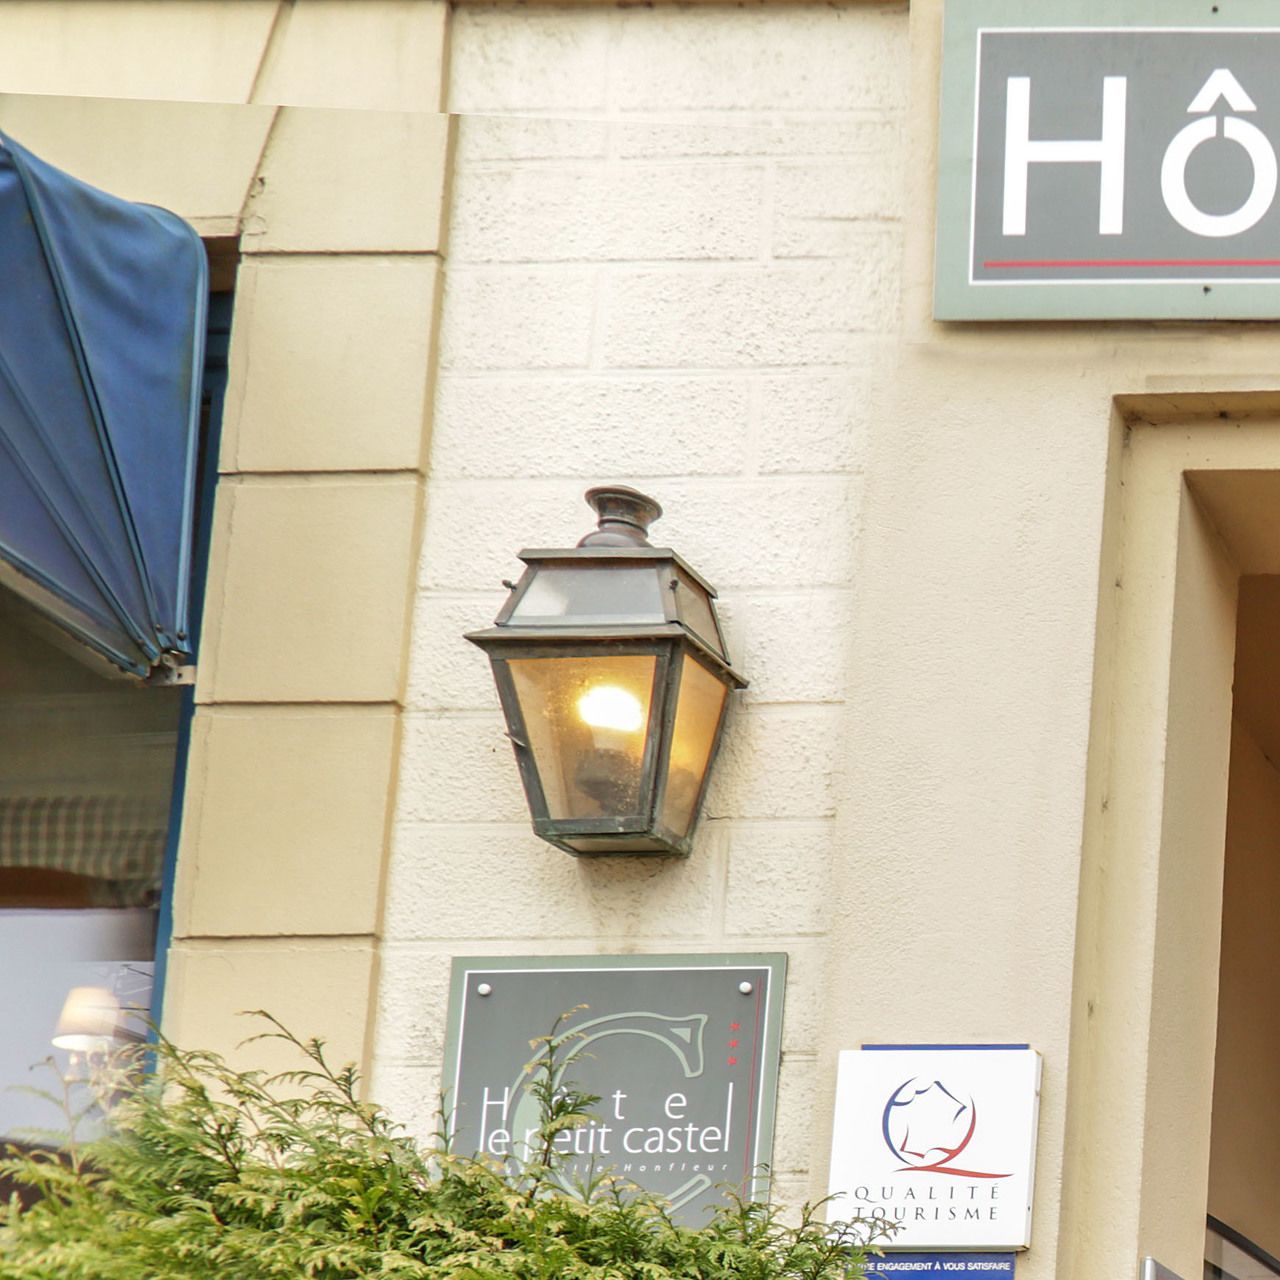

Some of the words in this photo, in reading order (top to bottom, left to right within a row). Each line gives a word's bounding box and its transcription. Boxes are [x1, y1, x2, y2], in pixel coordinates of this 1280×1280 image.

[622, 1098, 735, 1154] castel
[622, 1162, 729, 1173] Honfleur
[854, 1182, 1000, 1203] QUALITÉ
[853, 1206, 998, 1221] TOURISME
[876, 1262, 933, 1271] ENGAGEMENT
[934, 1260, 941, 1271] À
[942, 1262, 966, 1271] VOUS
[967, 1262, 1011, 1271] SATISFAIRE
